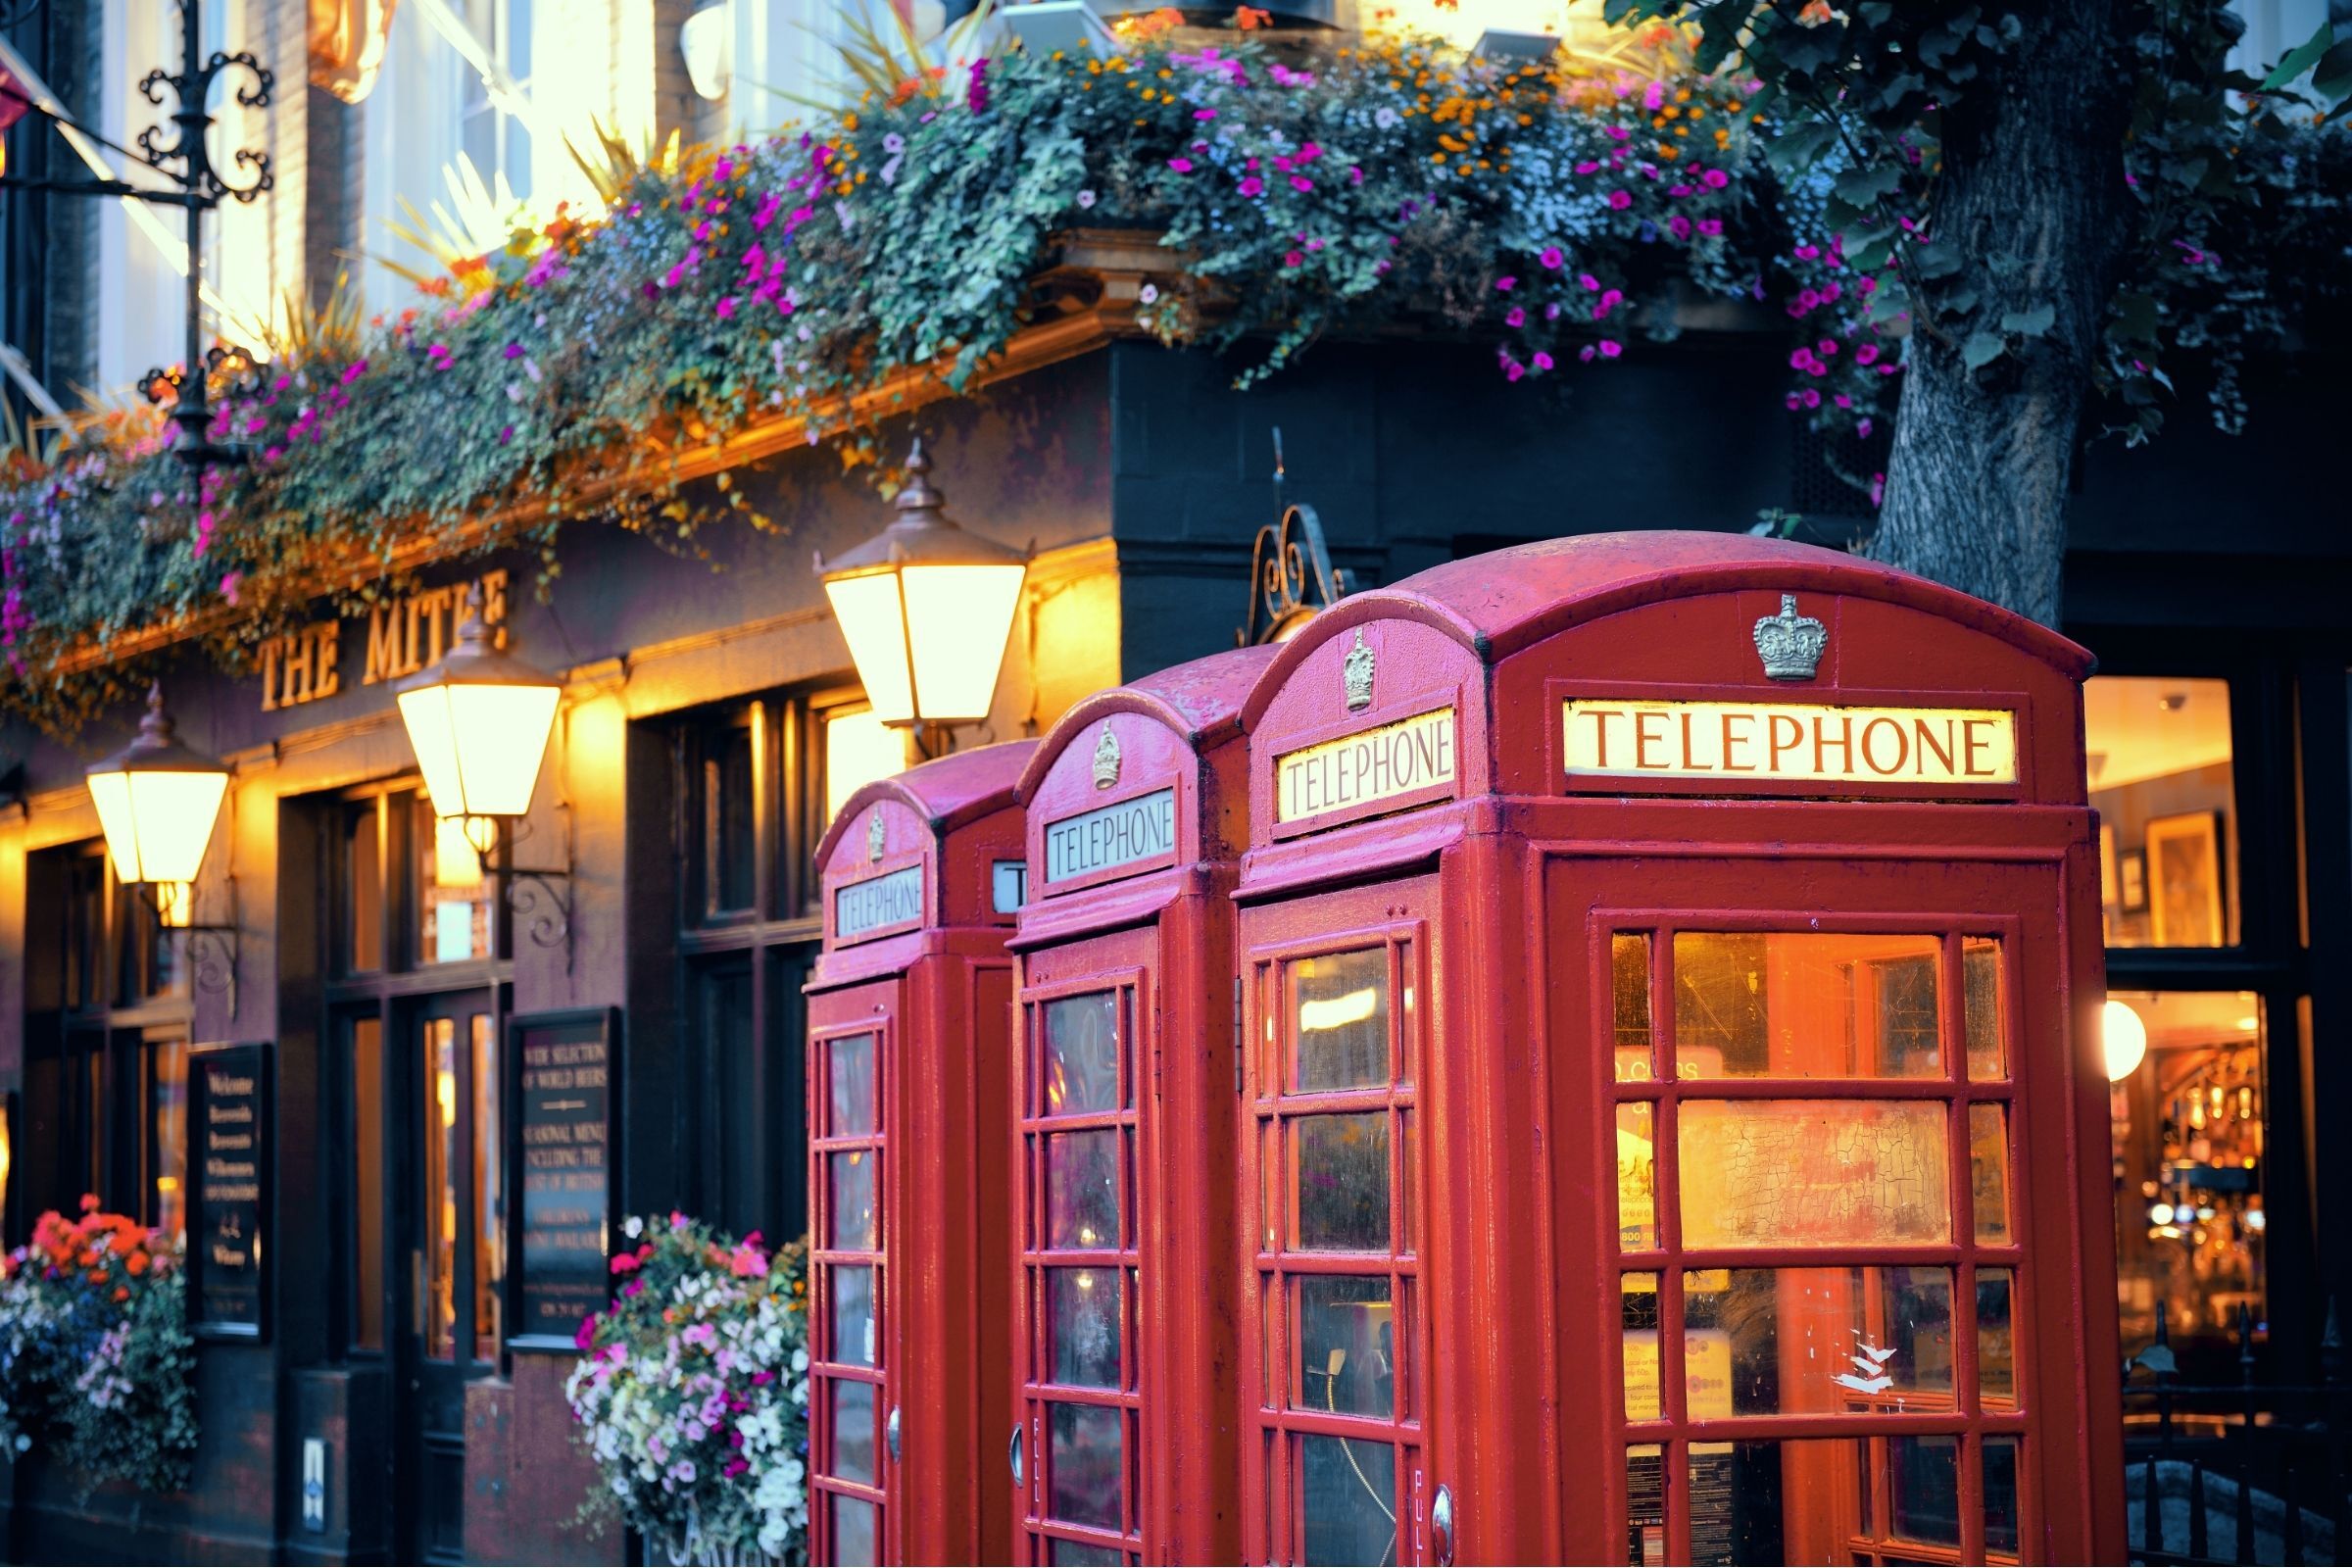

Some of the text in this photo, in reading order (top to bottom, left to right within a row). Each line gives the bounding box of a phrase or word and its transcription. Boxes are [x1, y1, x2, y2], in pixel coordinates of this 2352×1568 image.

[254, 619, 338, 711] THE
[1286, 718, 1453, 815] TELEPHONE
[1577, 710, 1997, 776] TELEPHONE
[1053, 799, 1173, 875] TELEPHONE
[842, 875, 920, 931] TELEPHONE
